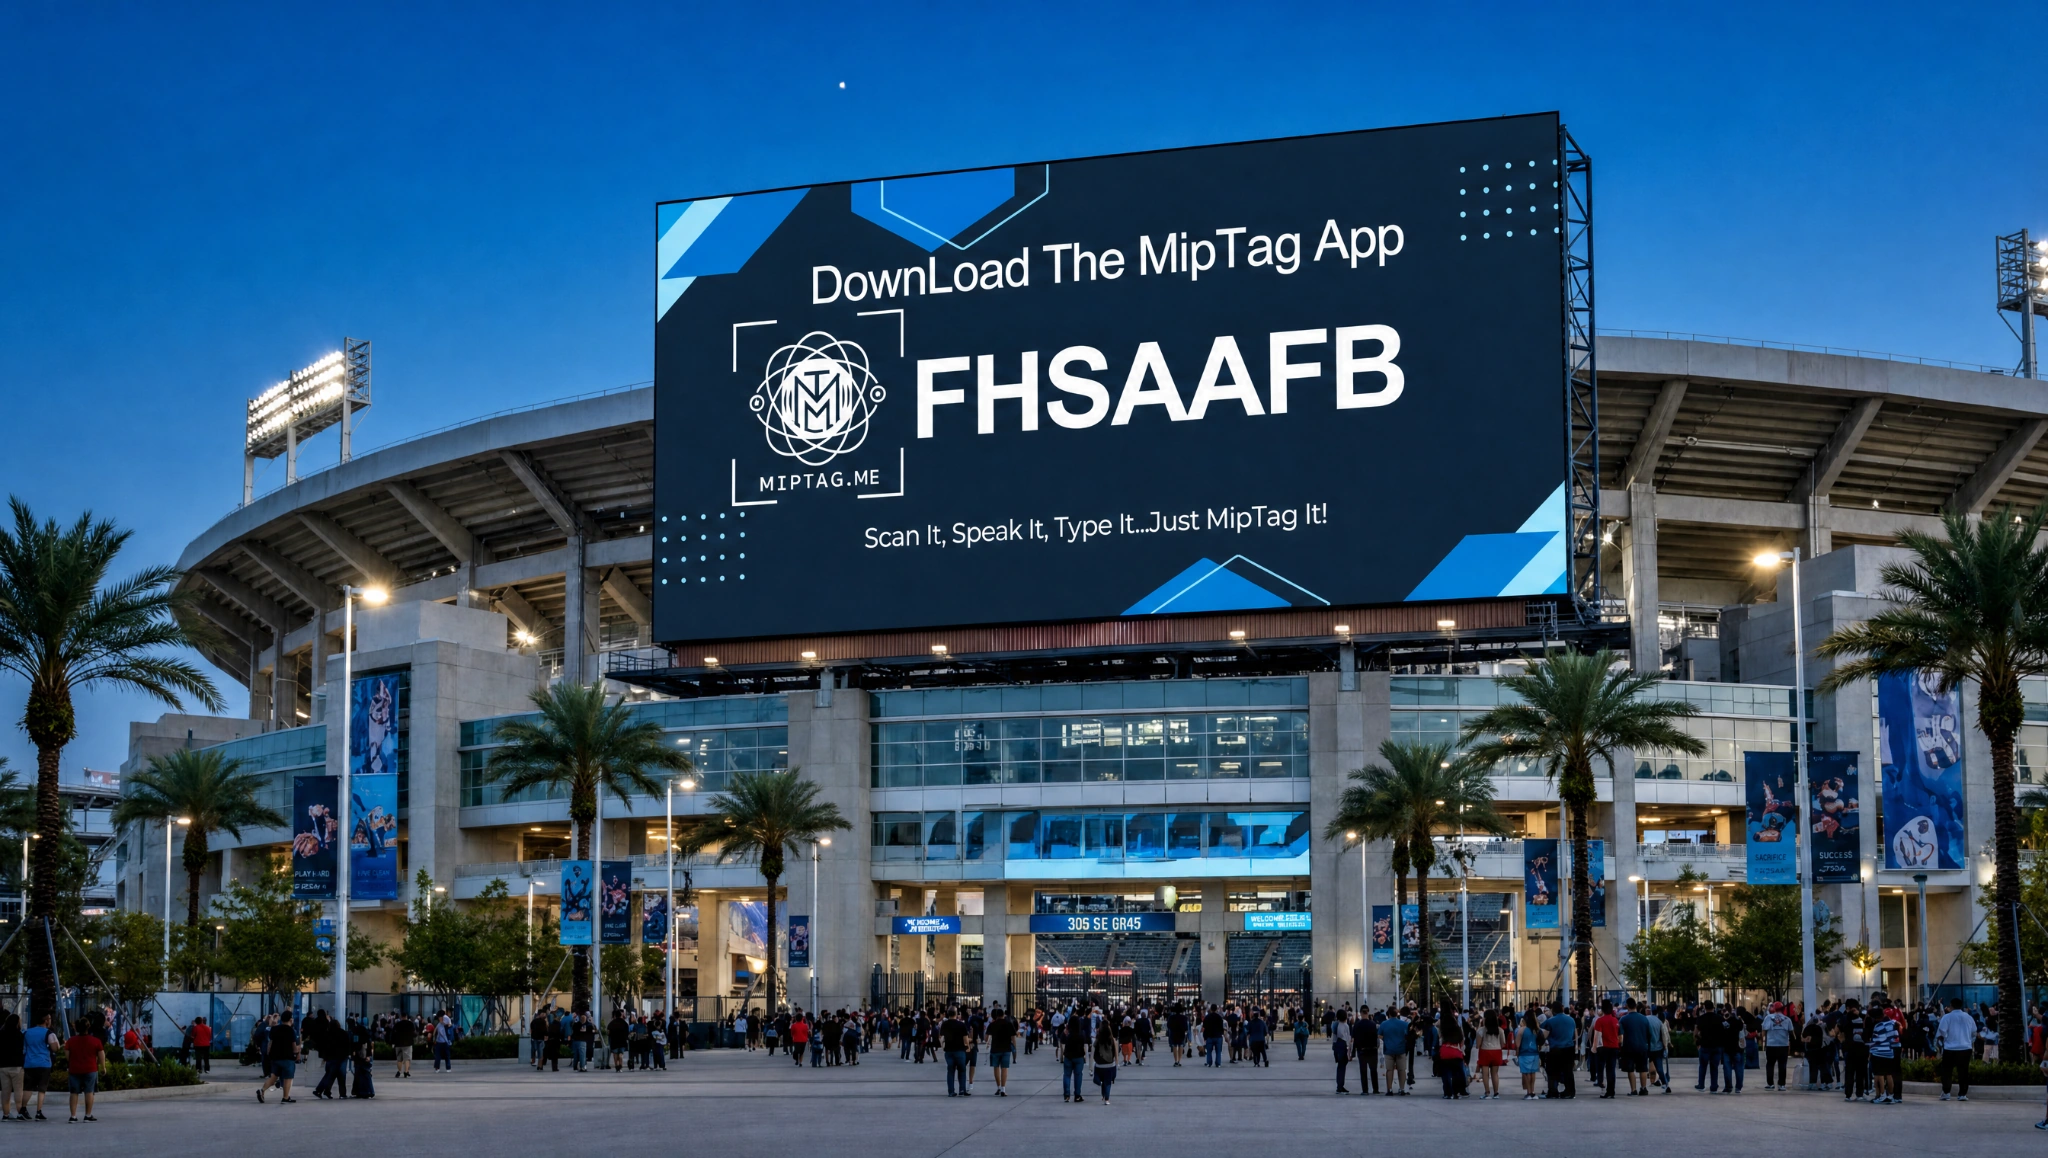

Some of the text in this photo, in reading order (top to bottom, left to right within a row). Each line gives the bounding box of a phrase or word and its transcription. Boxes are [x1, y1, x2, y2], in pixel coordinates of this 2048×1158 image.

[812, 218, 1405, 305] DownLoad The MipTag App
[916, 323, 1406, 439] FHSAAFB
[759, 469, 880, 492] MIPTAG.ME
[864, 527, 920, 549] Scan
[927, 524, 946, 548] It,
[952, 518, 1023, 549] Speak
[1029, 518, 1049, 543] It,
[1053, 516, 1113, 543] Type
[1207, 505, 1297, 534] MipTag
[1306, 502, 1327, 525] It!
[1754, 853, 1787, 861] SACRIFICE
[1818, 850, 1853, 860] SUCCESS
[294, 869, 311, 878] PLAY
[1093, 916, 1109, 931] SE
[1112, 916, 1142, 931] GR45
